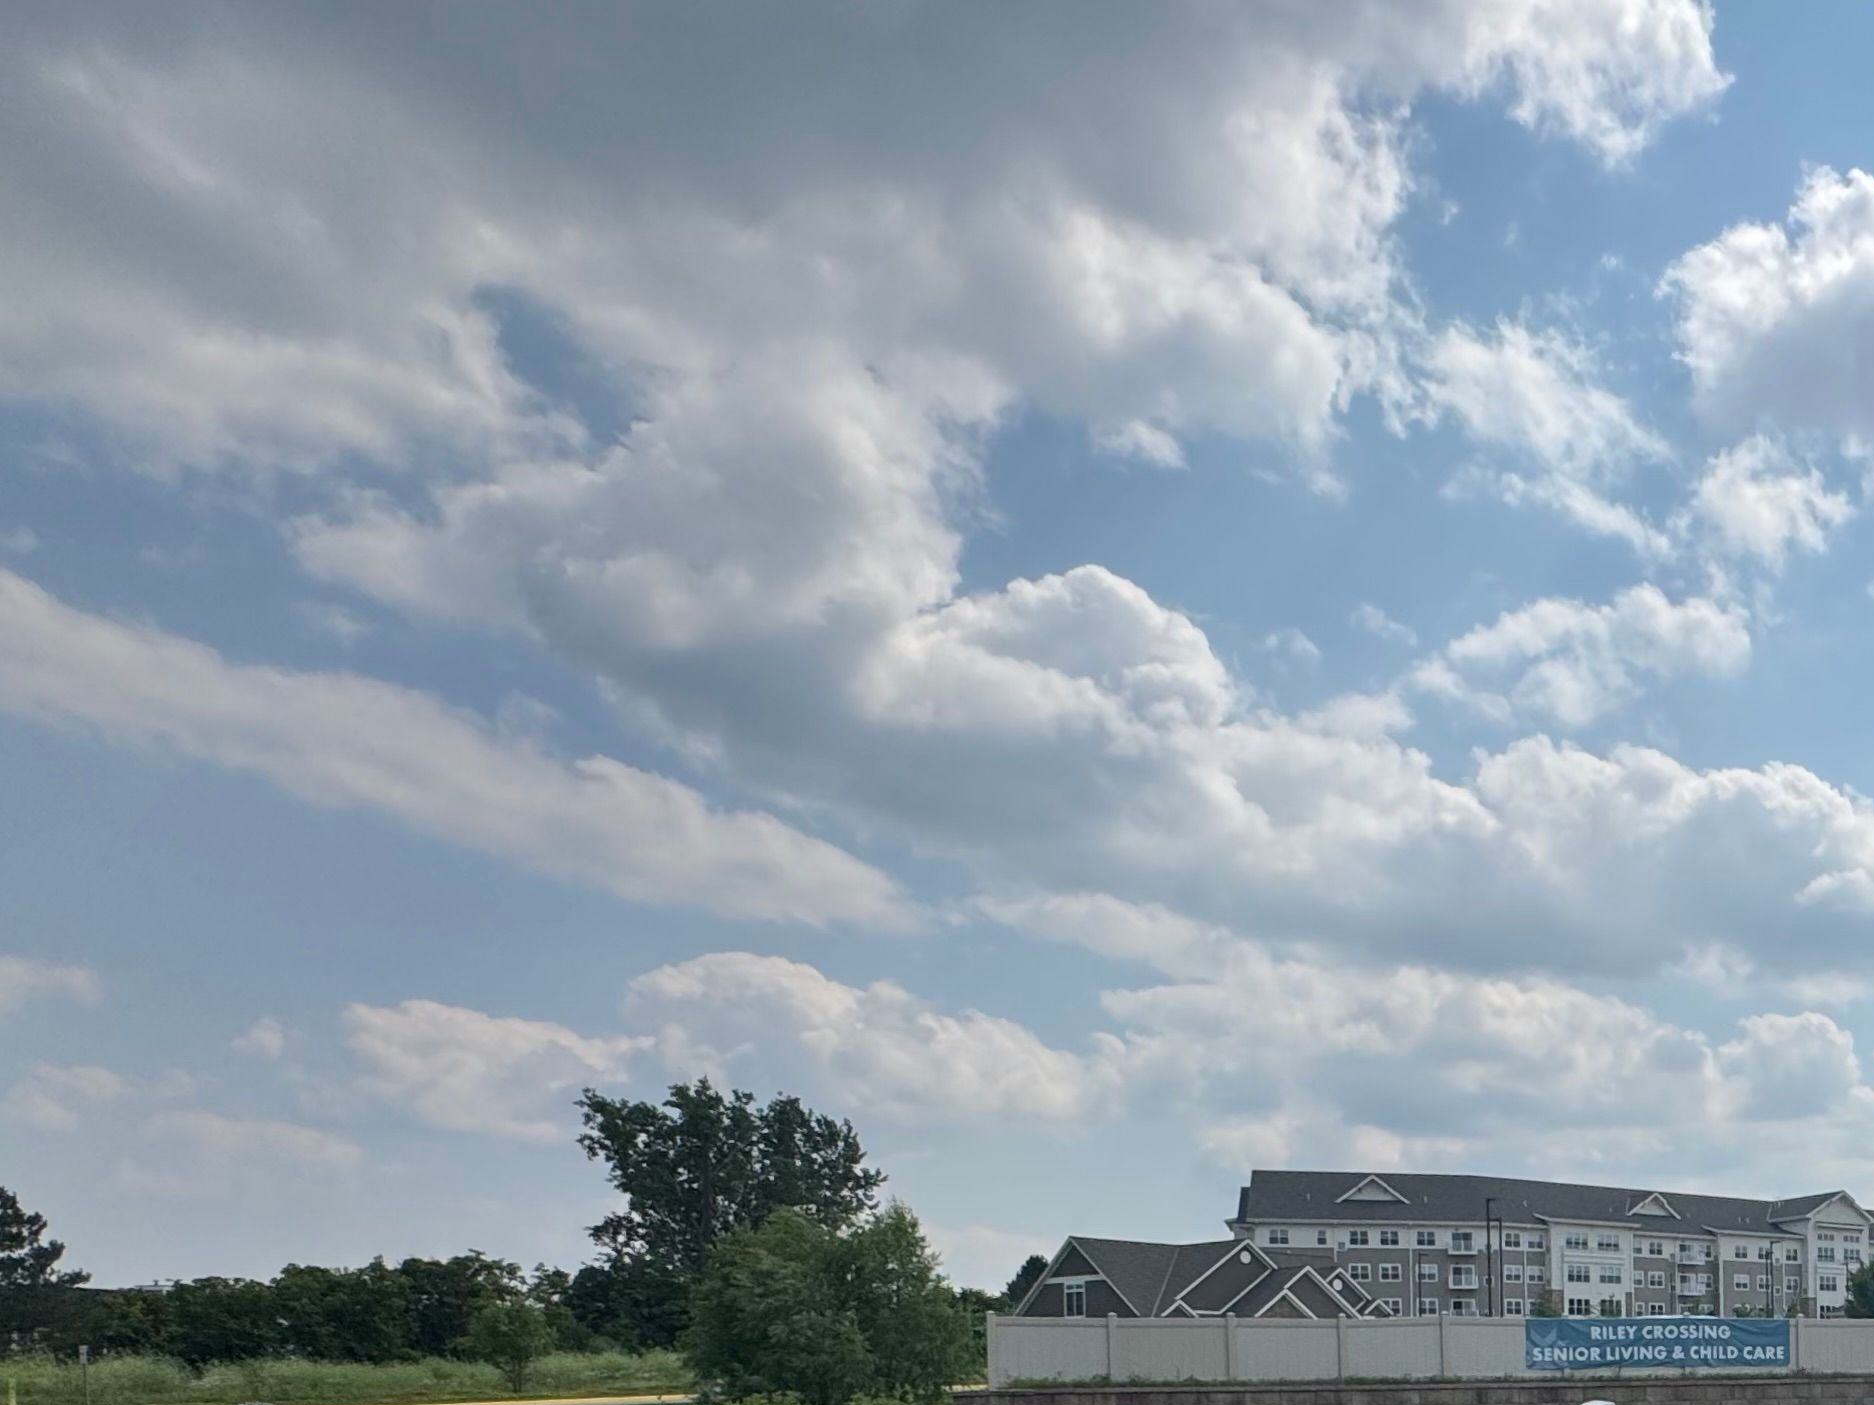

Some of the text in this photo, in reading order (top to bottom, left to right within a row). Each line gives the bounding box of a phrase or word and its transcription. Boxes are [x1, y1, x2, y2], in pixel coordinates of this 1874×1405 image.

[1591, 1325, 1731, 1339] RILEY CROSSING
[1533, 1346, 1784, 1361] SENIOR LIVING & CHILD CARE
